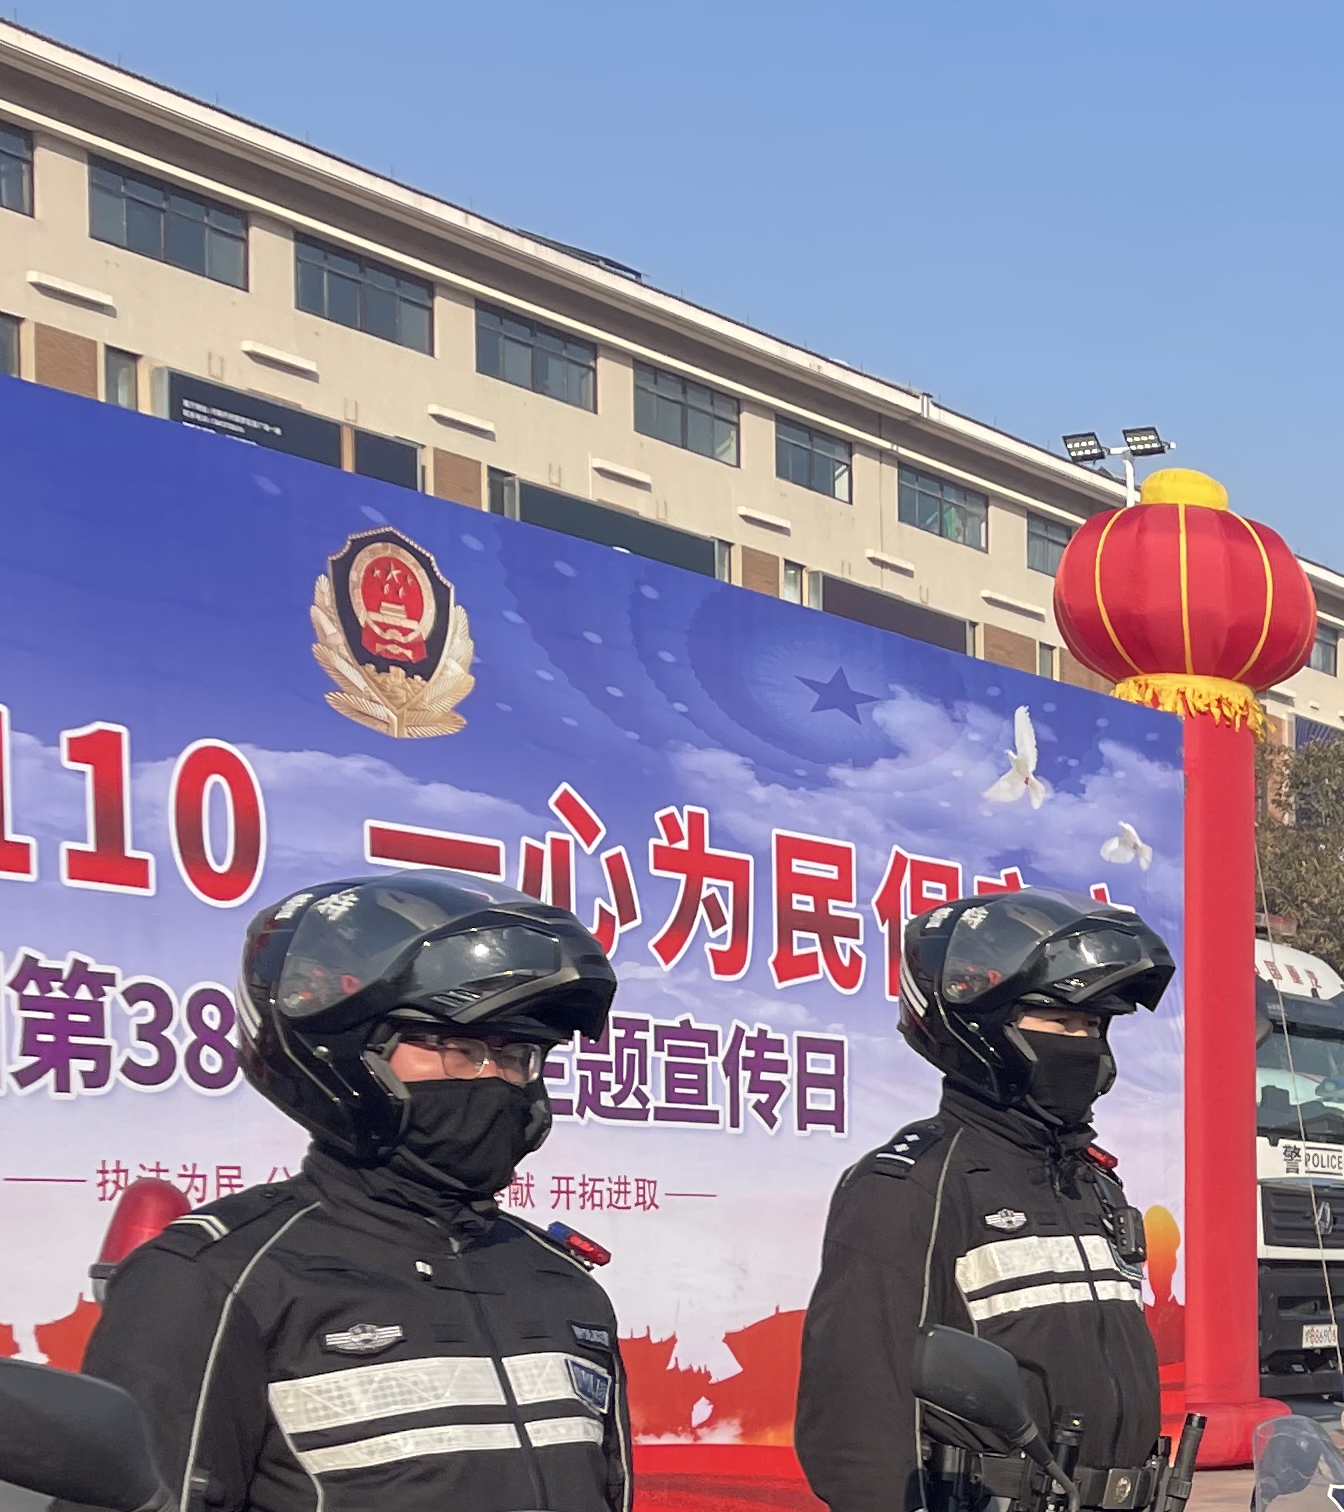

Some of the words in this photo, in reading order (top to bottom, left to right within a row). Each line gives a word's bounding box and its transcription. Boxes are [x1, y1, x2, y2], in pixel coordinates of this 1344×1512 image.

[1304, 1152, 1343, 1170] POLICE
[550, 1174, 660, 1211] 开拓进取
